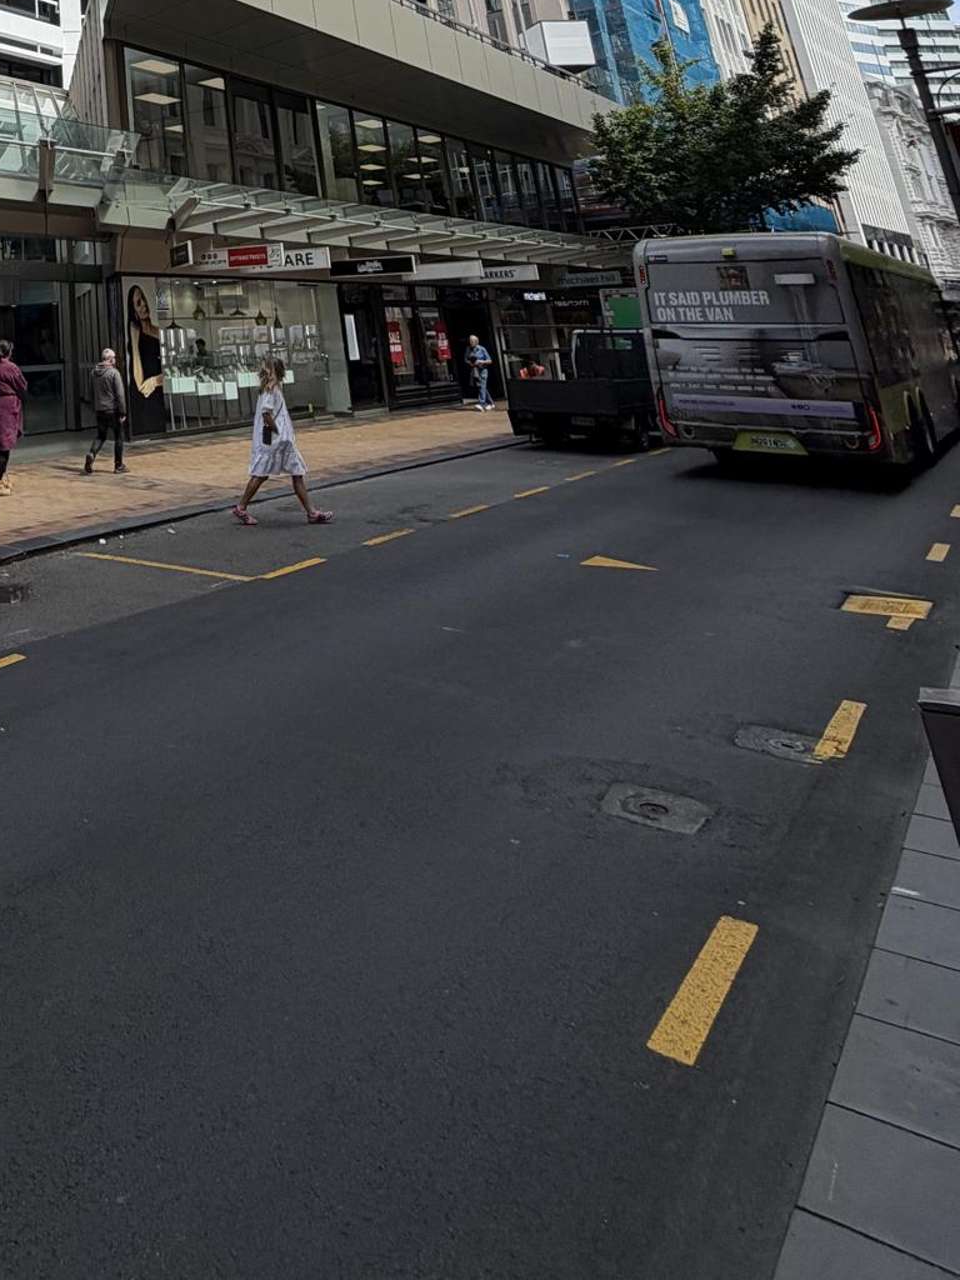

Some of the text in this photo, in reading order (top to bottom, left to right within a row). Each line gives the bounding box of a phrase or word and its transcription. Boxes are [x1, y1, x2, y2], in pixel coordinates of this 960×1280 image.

[283, 251, 314, 267] ARE
[481, 270, 515, 279] ARKERS
[654, 291, 770, 306] IT SAID PLUMBER
[657, 307, 734, 321] ON THE VAN
